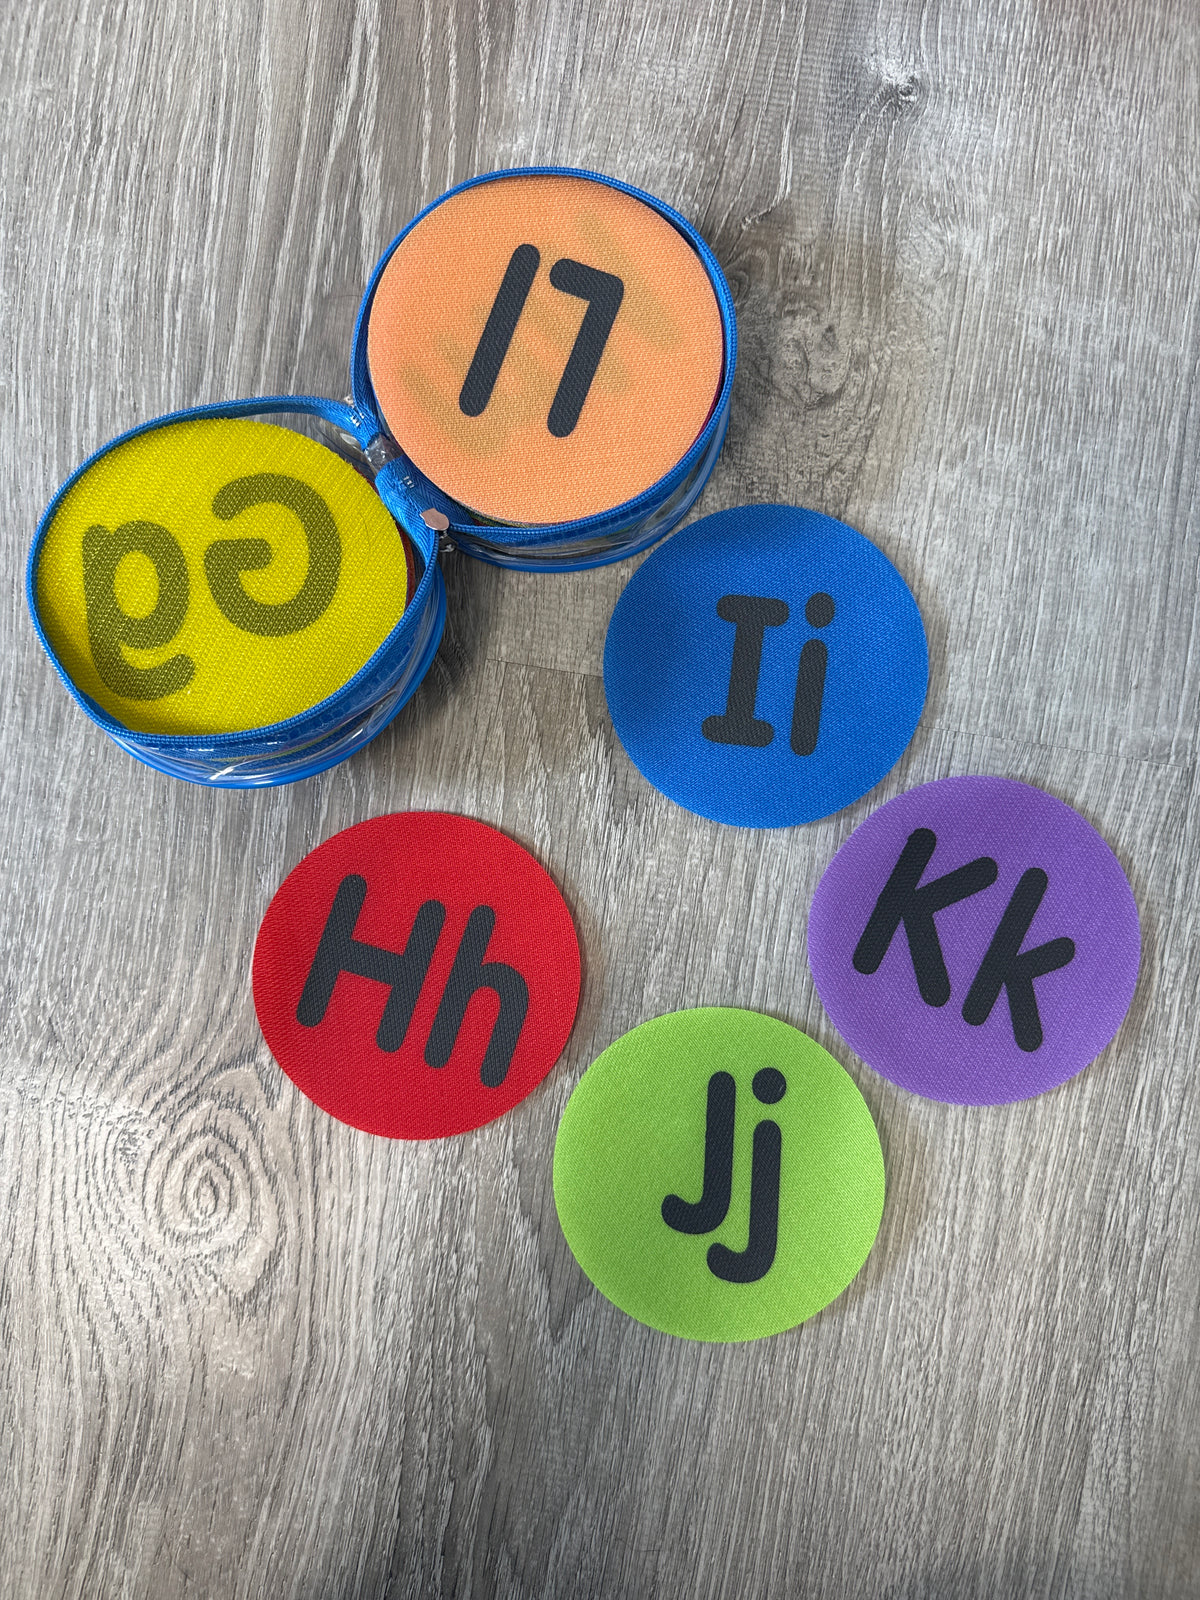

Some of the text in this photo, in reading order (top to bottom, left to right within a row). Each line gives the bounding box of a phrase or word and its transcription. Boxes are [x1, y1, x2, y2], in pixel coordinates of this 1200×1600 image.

[702, 592, 835, 756] Ii
[296, 873, 529, 1088] Hh
[852, 827, 1076, 1052] Kk
[661, 1067, 787, 1283] Jj
